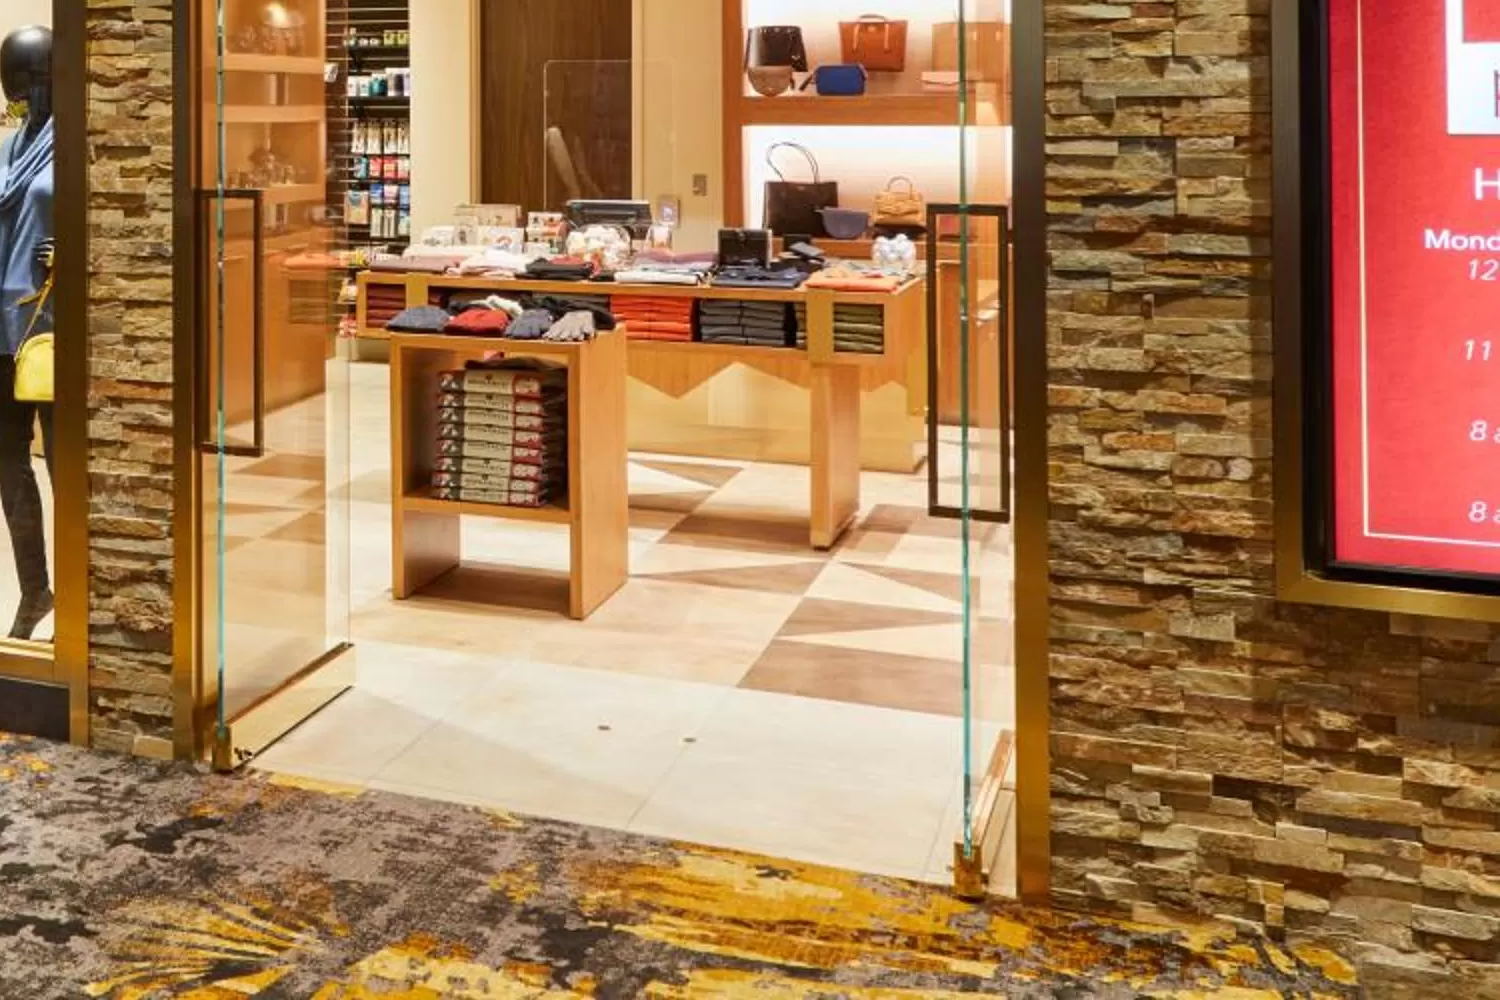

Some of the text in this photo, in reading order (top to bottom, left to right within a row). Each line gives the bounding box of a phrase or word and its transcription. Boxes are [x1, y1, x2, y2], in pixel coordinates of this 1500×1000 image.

[1468, 257, 1500, 281] 12
[1464, 338, 1492, 361] 11
[1468, 419, 1488, 442] 8
[1467, 500, 1487, 524] 8
